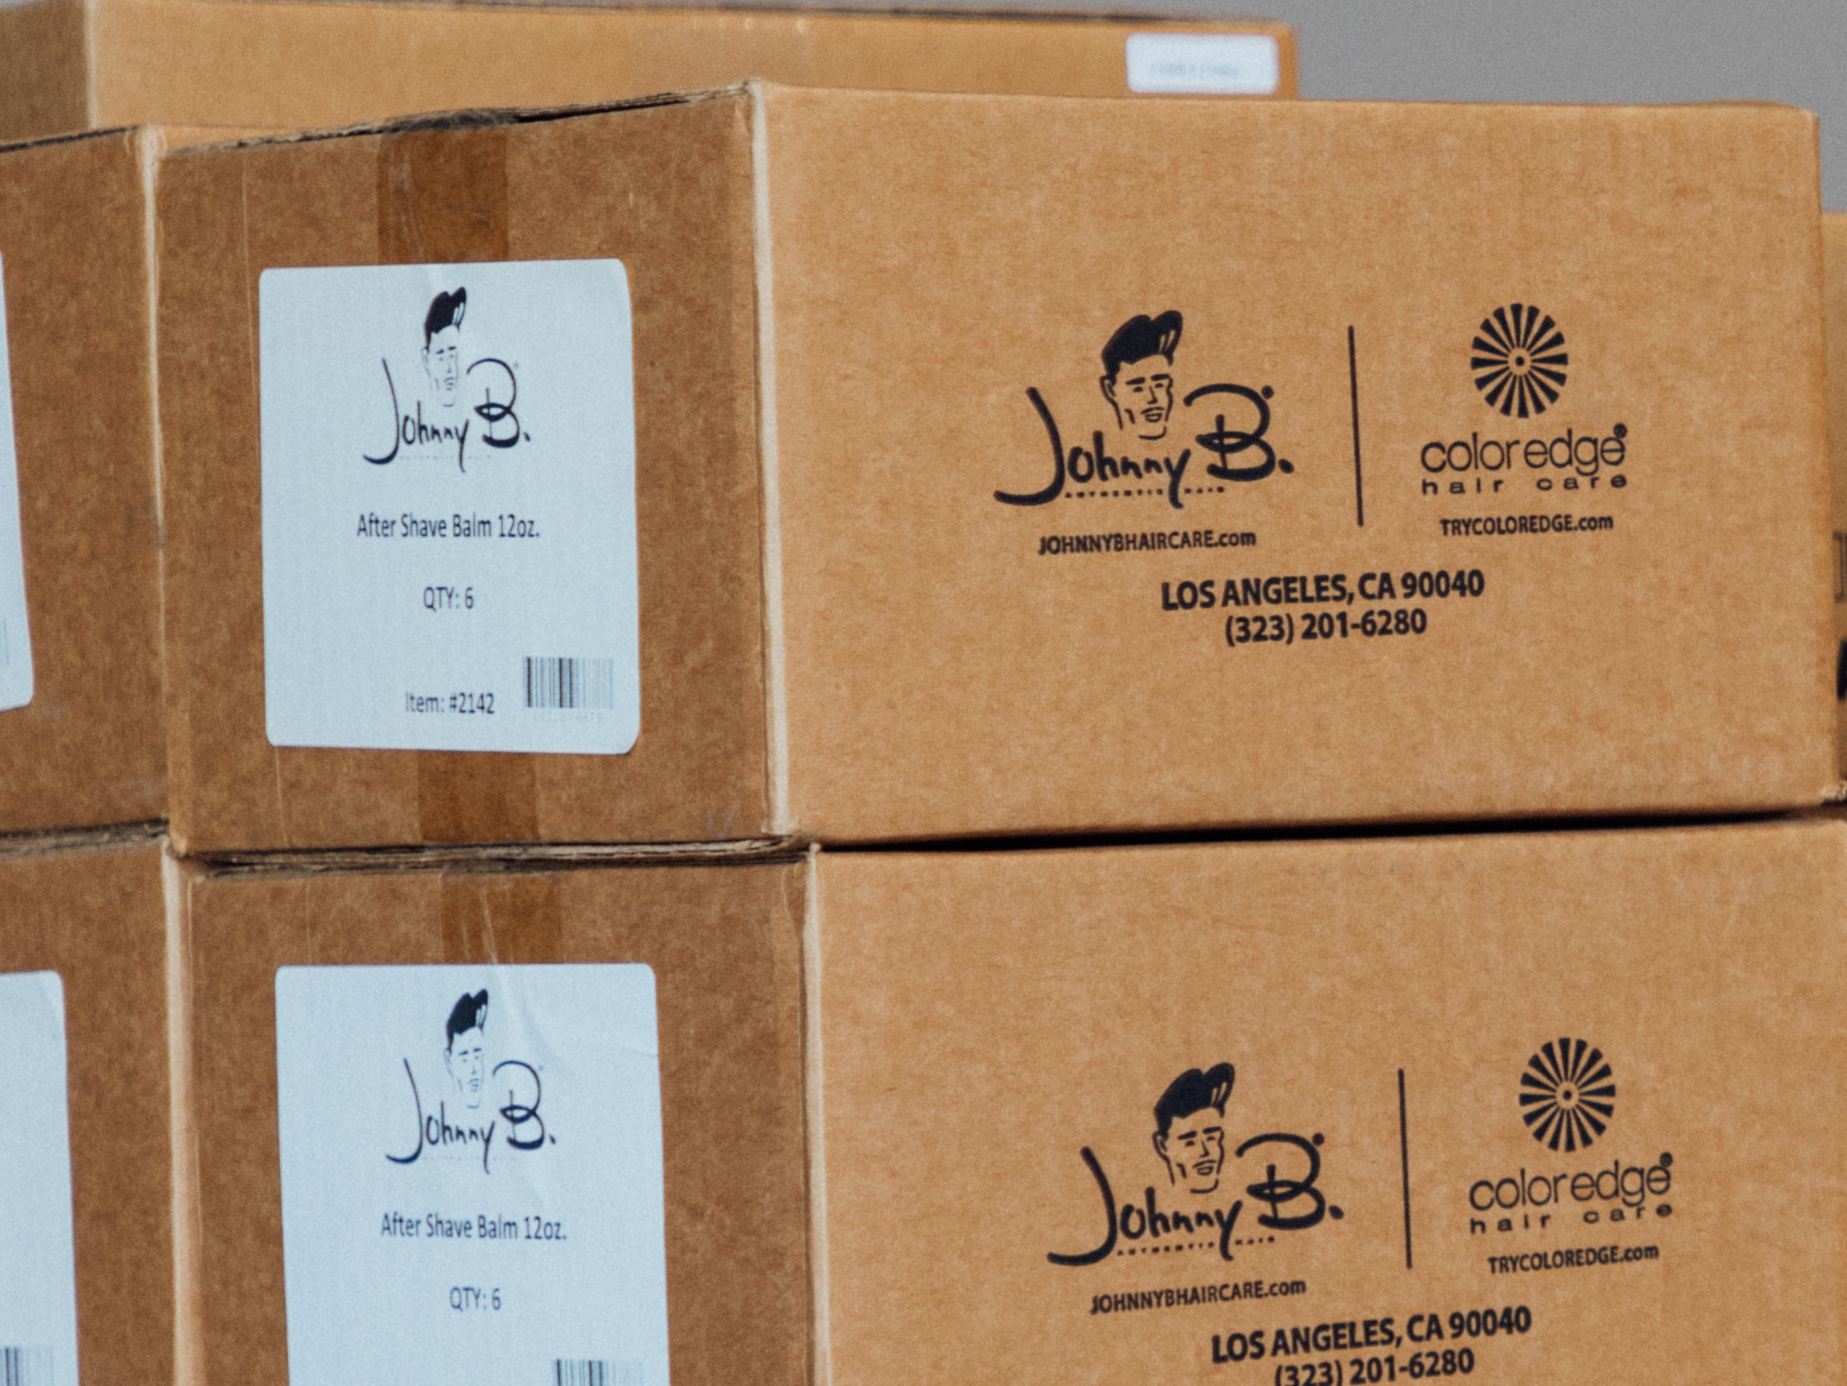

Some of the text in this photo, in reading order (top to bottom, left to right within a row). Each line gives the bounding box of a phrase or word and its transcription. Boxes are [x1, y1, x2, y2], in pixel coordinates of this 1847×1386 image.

[362, 358, 469, 474] Johnny
[993, 386, 1191, 509] Johnny
[1419, 426, 1627, 477] coloredge
[1421, 474, 1628, 496] hair care
[356, 512, 541, 541] After Shave Balm 12oz.
[1038, 529, 1257, 556] JOHNNYBHAIRCARE.com
[1439, 514, 1614, 537] TRYCOLOREDGE.com
[422, 585, 475, 614] QTY: 6
[1160, 568, 1486, 611] LOS ANGELES, CA 90040
[1224, 608, 1428, 647] (323) 201-6280
[404, 690, 496, 717] Item: #2142
[385, 1058, 496, 1174] Johnny
[1469, 1158, 1672, 1212] coloredge
[1046, 1146, 1243, 1268] Johnny
[1469, 1202, 1674, 1236] hair care
[380, 1213, 568, 1242] After Shave Balm 12oz.
[1487, 1243, 1661, 1276] TRYCOLOREDGE.com
[449, 1286, 502, 1314] QTY: 6
[1089, 1279, 1307, 1316] JOHNNYBHAIRCARE.com
[1210, 1305, 1533, 1364] LOS ANGELES, CA 90040
